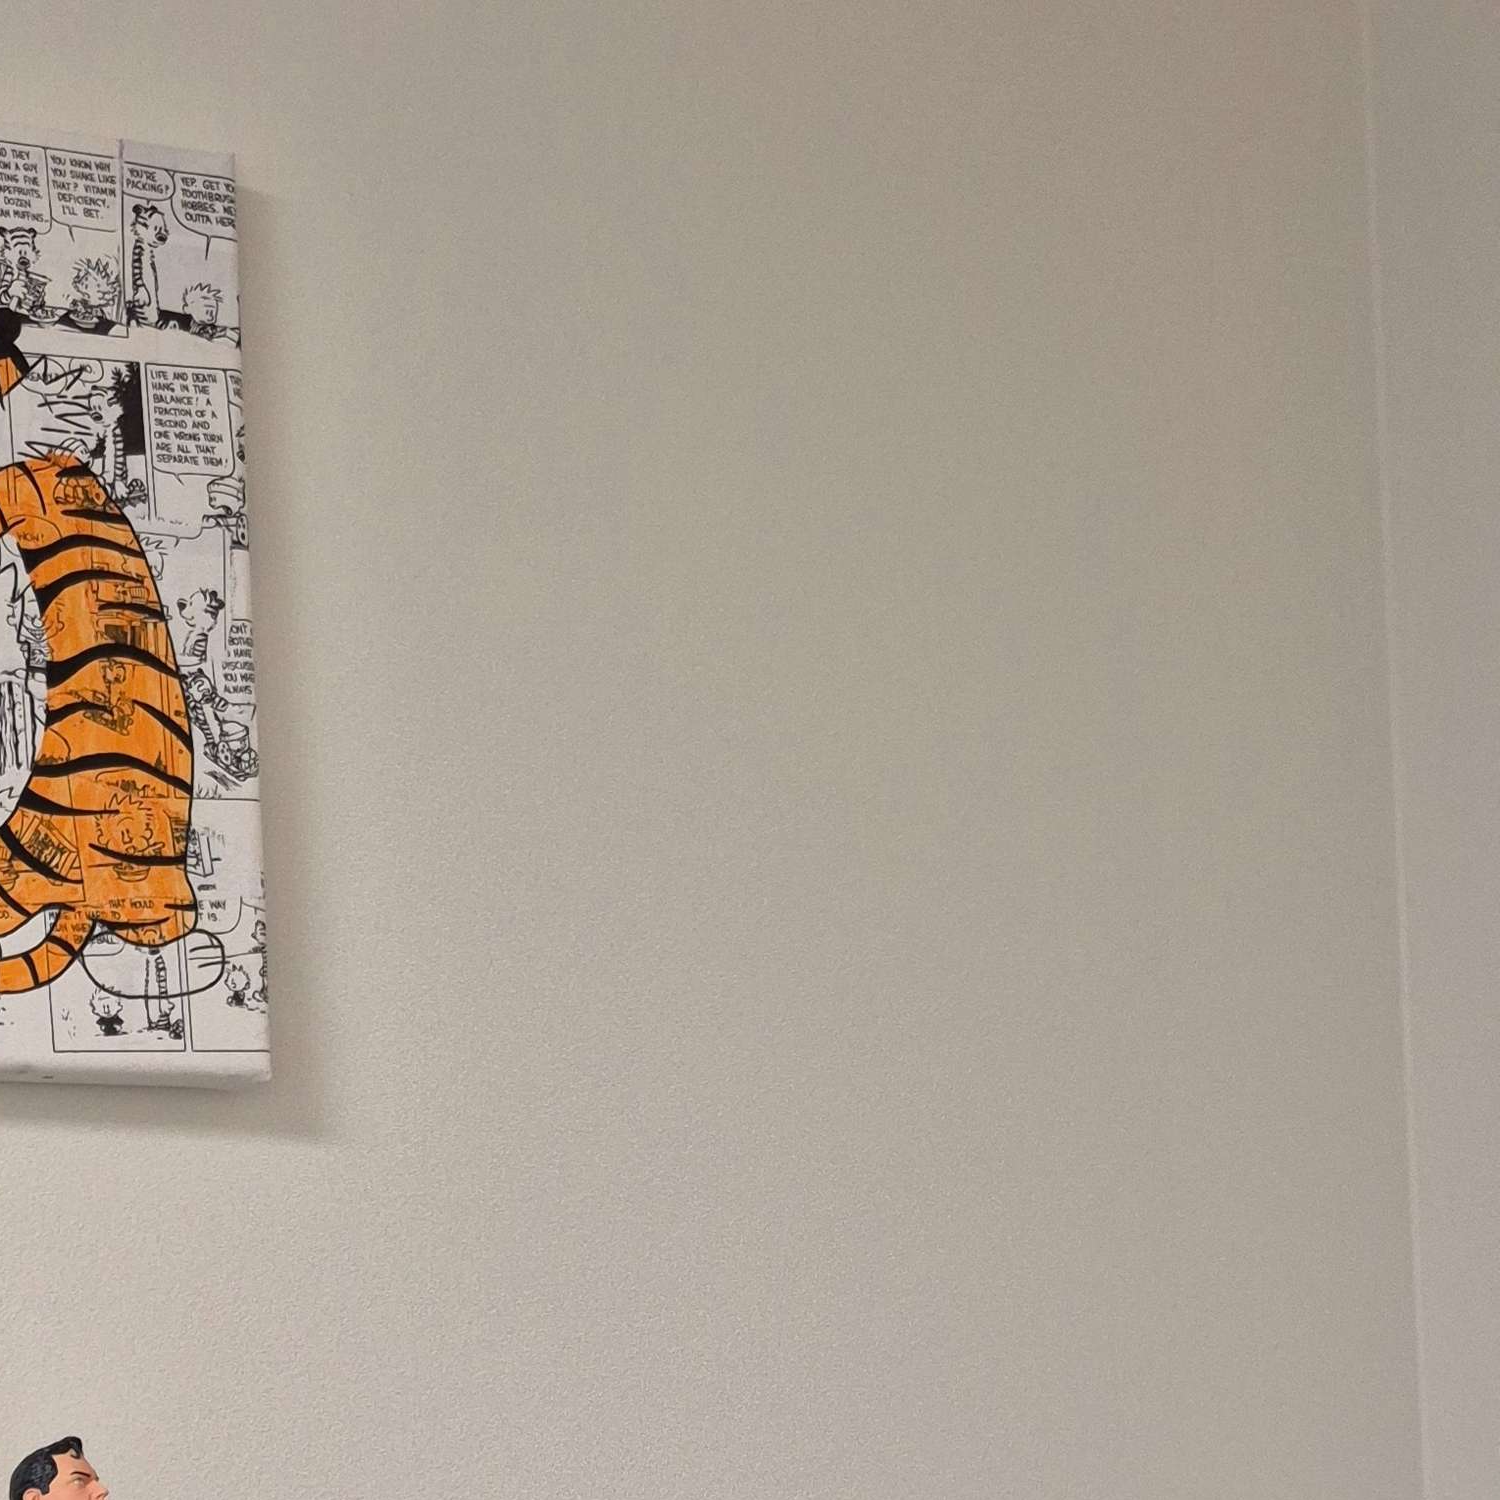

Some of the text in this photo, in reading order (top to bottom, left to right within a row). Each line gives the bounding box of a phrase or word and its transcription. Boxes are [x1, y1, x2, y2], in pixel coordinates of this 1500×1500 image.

[11, 149, 30, 161] THEY
[14, 161, 20, 171] A
[22, 162, 38, 174] GUY
[50, 154, 111, 172] YOU KNOW WHY
[23, 175, 40, 187] FIVE
[50, 167, 117, 185] YOU SHAKE LIKE
[83, 183, 116, 198] VITAMIN
[126, 178, 169, 194] PACKING?
[202, 180, 220, 191] GET
[3, 196, 32, 209] DOZEN
[185, 213, 212, 225] OUTTA
[151, 370, 217, 384] LIFE AND DEATH
[151, 382, 210, 395] HANG IN THE
[206, 398, 212, 407] A
[154, 406, 218, 419] FRACTION OF A
[154, 418, 210, 430] SECOND AND
[154, 431, 224, 443] ONE WRONG TURN
[156, 442, 217, 455] ARE ALL THAT
[156, 454, 200, 465] SEPARATE
[209, 900, 226, 910] WAY
